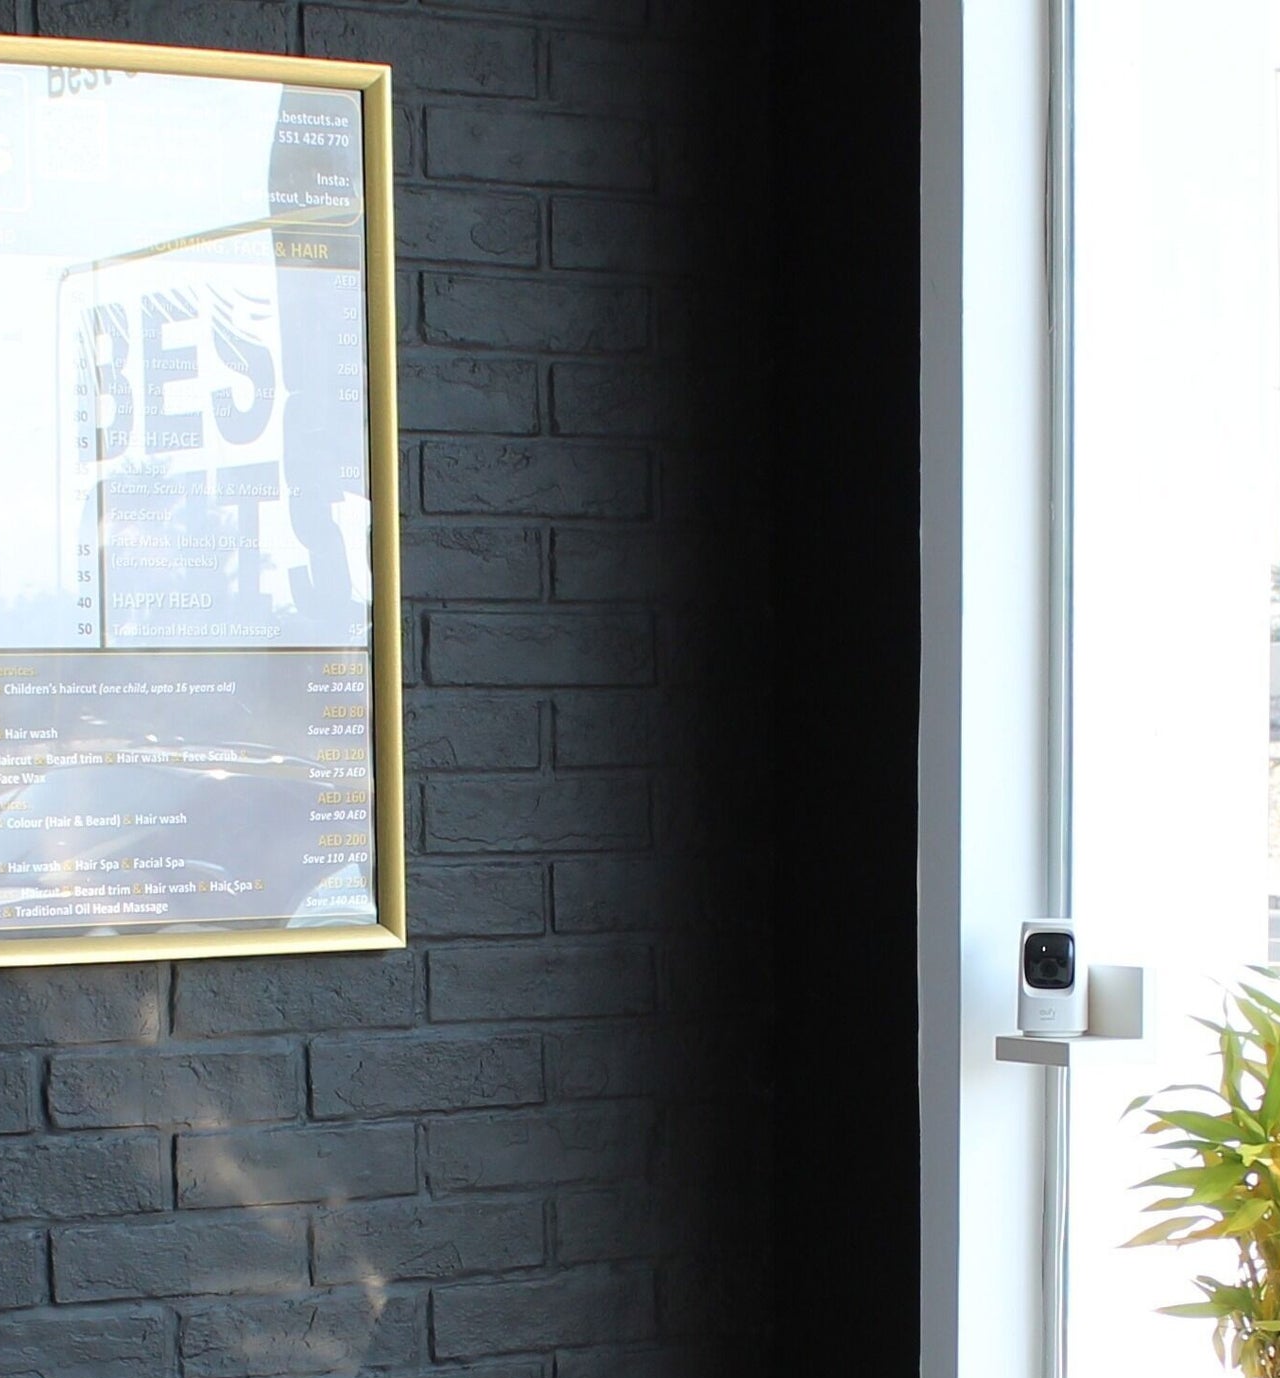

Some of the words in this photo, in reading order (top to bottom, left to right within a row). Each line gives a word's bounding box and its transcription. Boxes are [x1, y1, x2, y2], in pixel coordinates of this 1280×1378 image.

[279, 130, 301, 145] 551
[302, 132, 325, 146] 426
[326, 133, 350, 148] 770
[317, 172, 350, 187] Insta:
[291, 243, 328, 259] HAIR
[343, 308, 357, 319] 50
[337, 333, 357, 346] 100
[337, 363, 358, 375] 260
[338, 389, 358, 401] 160
[161, 432, 203, 448] FACE
[338, 466, 360, 479] 100
[139, 535, 172, 549] Mask
[176, 534, 217, 551] (black)
[218, 536, 237, 550] OR
[76, 571, 91, 583] 35
[76, 597, 92, 610] 40
[111, 591, 165, 609] HAPPY
[169, 591, 214, 609] HEAD
[77, 623, 92, 636] 50
[179, 623, 209, 637] Head
[210, 623, 227, 636] Oil
[229, 623, 281, 639] Massage
[321, 663, 346, 676] AED
[4, 682, 57, 696] Children's
[58, 682, 97, 696] haircut
[98, 682, 122, 696] (one
[122, 681, 149, 697] child,
[150, 682, 174, 698] upto
[174, 681, 187, 694] 16
[189, 683, 215, 698] years
[216, 680, 237, 695] old)
[306, 681, 329, 693] Save
[330, 681, 343, 693] 30
[344, 681, 364, 693] AED
[321, 705, 346, 719] AED
[4, 727, 28, 740] Hair
[29, 727, 58, 740] wash
[307, 724, 330, 736] Save
[330, 724, 343, 736] 30
[344, 724, 365, 736] AED
[46, 752, 78, 765] Beard
[80, 752, 103, 765] trim
[116, 751, 139, 765] Hair
[141, 751, 169, 764] wash
[183, 750, 206, 762] Face
[207, 749, 238, 762] Scrub
[317, 748, 341, 762] AED
[344, 748, 364, 761] 120
[22, 772, 46, 785] Wax
[308, 767, 332, 779] Save
[332, 767, 345, 779] 75
[345, 766, 365, 778] AED
[317, 791, 342, 804] AED
[6, 816, 43, 830] Colour
[44, 815, 72, 831] (Hair
[73, 815, 84, 828] &
[85, 814, 121, 829] Beard)
[135, 813, 158, 826] Hair
[159, 812, 187, 825] wash
[309, 809, 332, 822] Save
[332, 809, 345, 821] 90
[346, 809, 367, 821] AED
[318, 834, 342, 847] AED
[345, 834, 366, 847] 200
[7, 861, 31, 874] Hair
[32, 860, 61, 874] wash
[75, 859, 98, 873] Hair
[100, 858, 120, 873] Spa
[133, 856, 163, 870] Facial
[164, 856, 185, 871] Spa
[302, 852, 326, 865] Save
[327, 852, 345, 864] 110
[347, 852, 368, 864] AED
[21, 886, 61, 898] Haircut
[74, 885, 106, 898] Beard
[107, 884, 131, 896] trim
[144, 882, 168, 895] Hair
[169, 881, 197, 894] wash
[233, 879, 253, 893] Spa
[305, 896, 329, 908] Save
[14, 905, 74, 919] Traditional
[74, 904, 91, 916] Oil
[92, 902, 121, 916] Head
[122, 901, 169, 917] Massage
